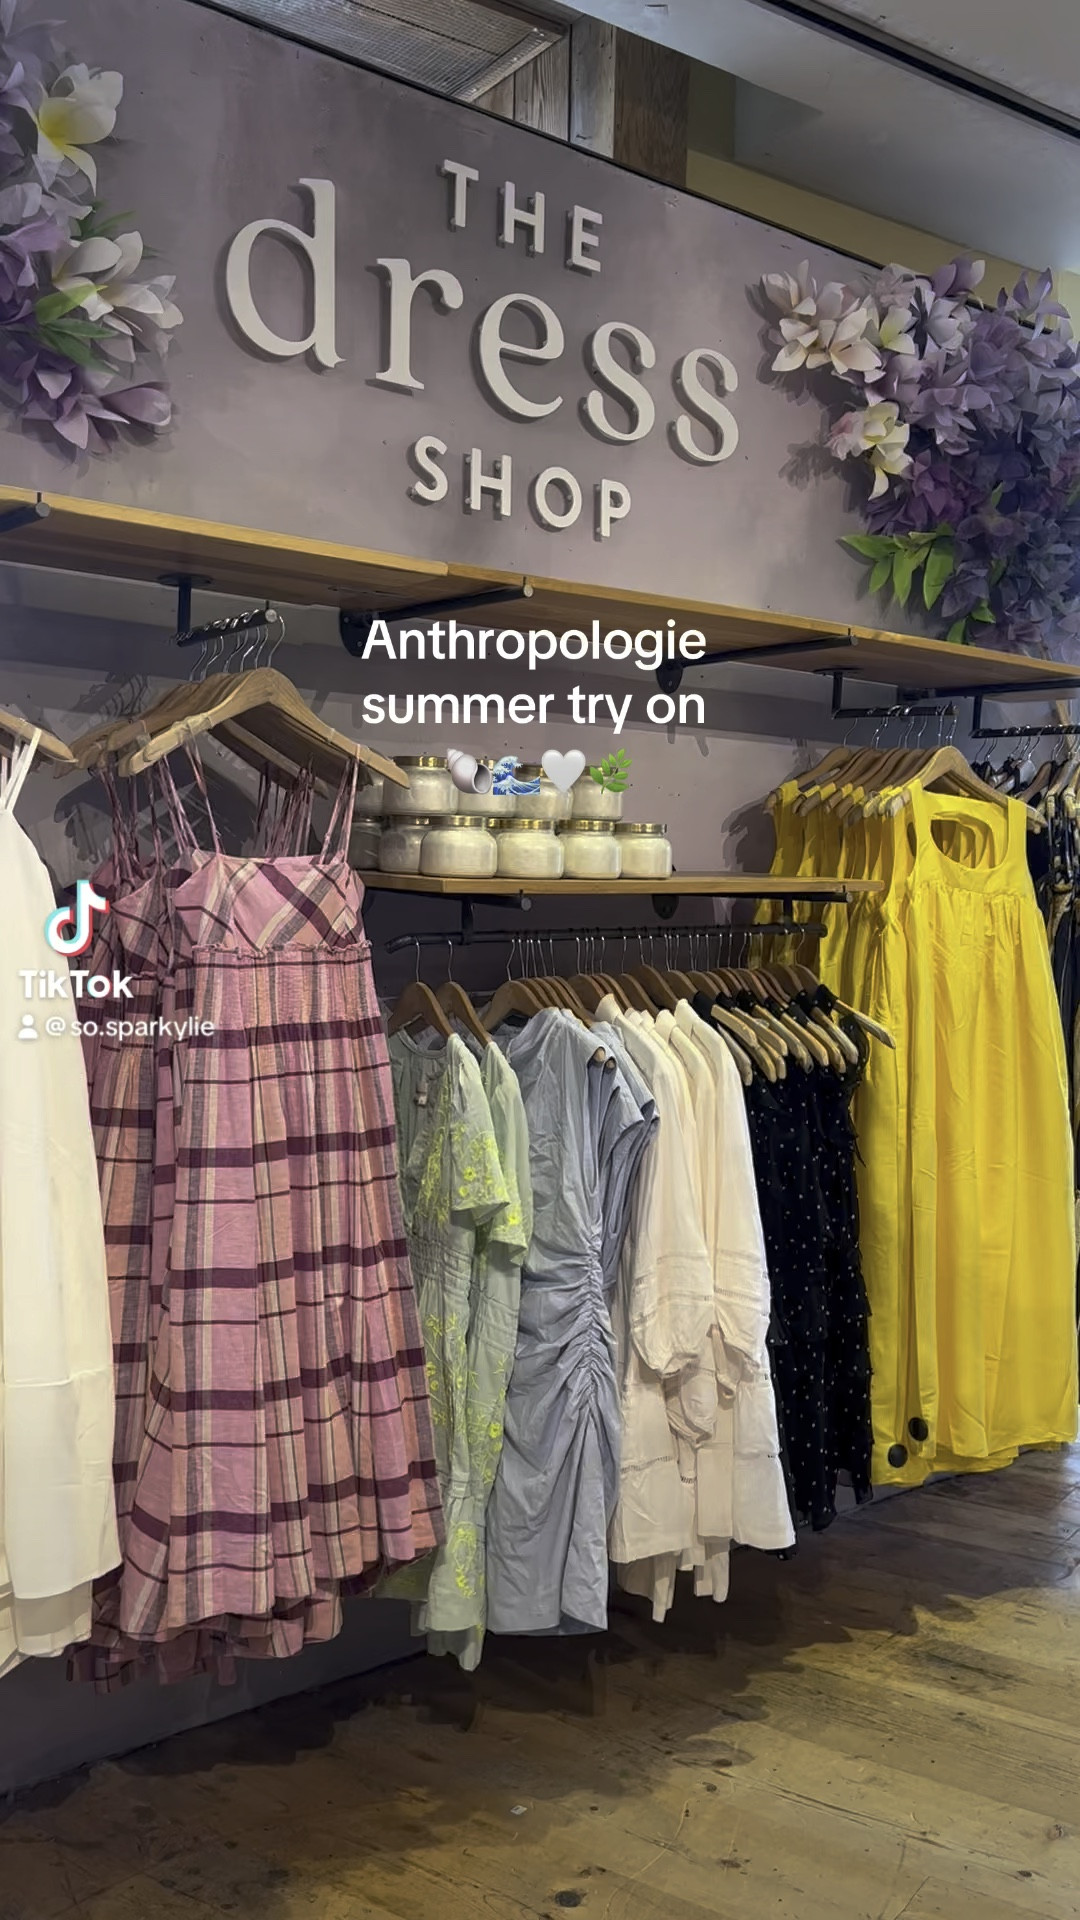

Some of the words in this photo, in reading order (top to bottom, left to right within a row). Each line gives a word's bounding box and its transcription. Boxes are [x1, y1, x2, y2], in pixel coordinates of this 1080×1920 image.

[442, 159, 604, 273] THE
[224, 177, 741, 464] dress
[411, 435, 633, 538] SHOP
